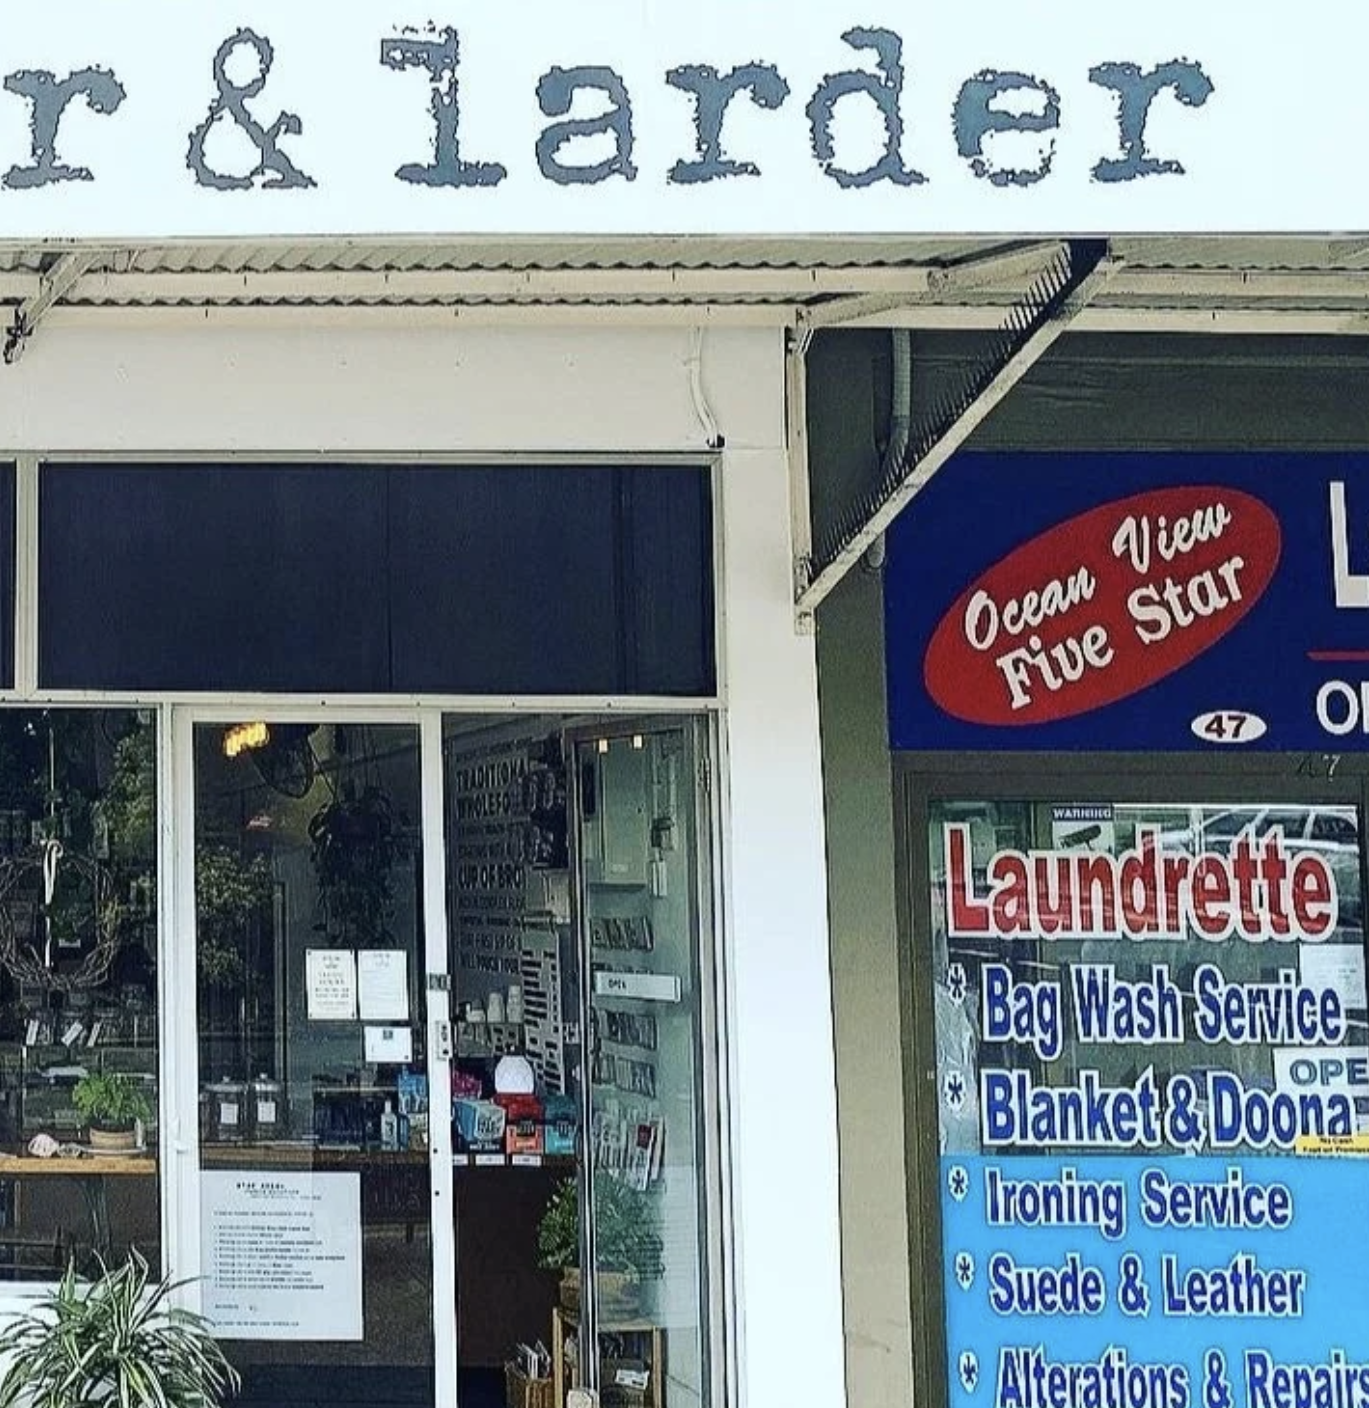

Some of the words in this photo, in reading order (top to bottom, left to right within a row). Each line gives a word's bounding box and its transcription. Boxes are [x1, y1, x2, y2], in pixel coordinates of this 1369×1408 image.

[185, 26, 318, 190] &
[379, 19, 1215, 189] larder
[963, 565, 1097, 652] Ocean
[1111, 501, 1233, 574] View
[995, 624, 1115, 712] Five
[1127, 554, 1246, 646] Star
[1204, 715, 1247, 739] 47
[1053, 807, 1111, 819] WARNING
[947, 823, 1335, 940] Laundrette
[983, 965, 1059, 1057] Bag
[1072, 964, 1183, 1042] Wash
[1195, 963, 1346, 1043] Service
[982, 1068, 1157, 1144] Blanket
[1166, 1075, 1206, 1145] &
[1210, 1070, 1354, 1145] Doona
[985, 1169, 1124, 1238] Ironing
[1141, 1169, 1292, 1227] Service
[988, 1254, 1105, 1315] Suede
[1119, 1254, 1151, 1316] &
[1164, 1254, 1306, 1316] Leather
[997, 1347, 1189, 1408] Alterations
[1203, 1349, 1233, 1408] &
